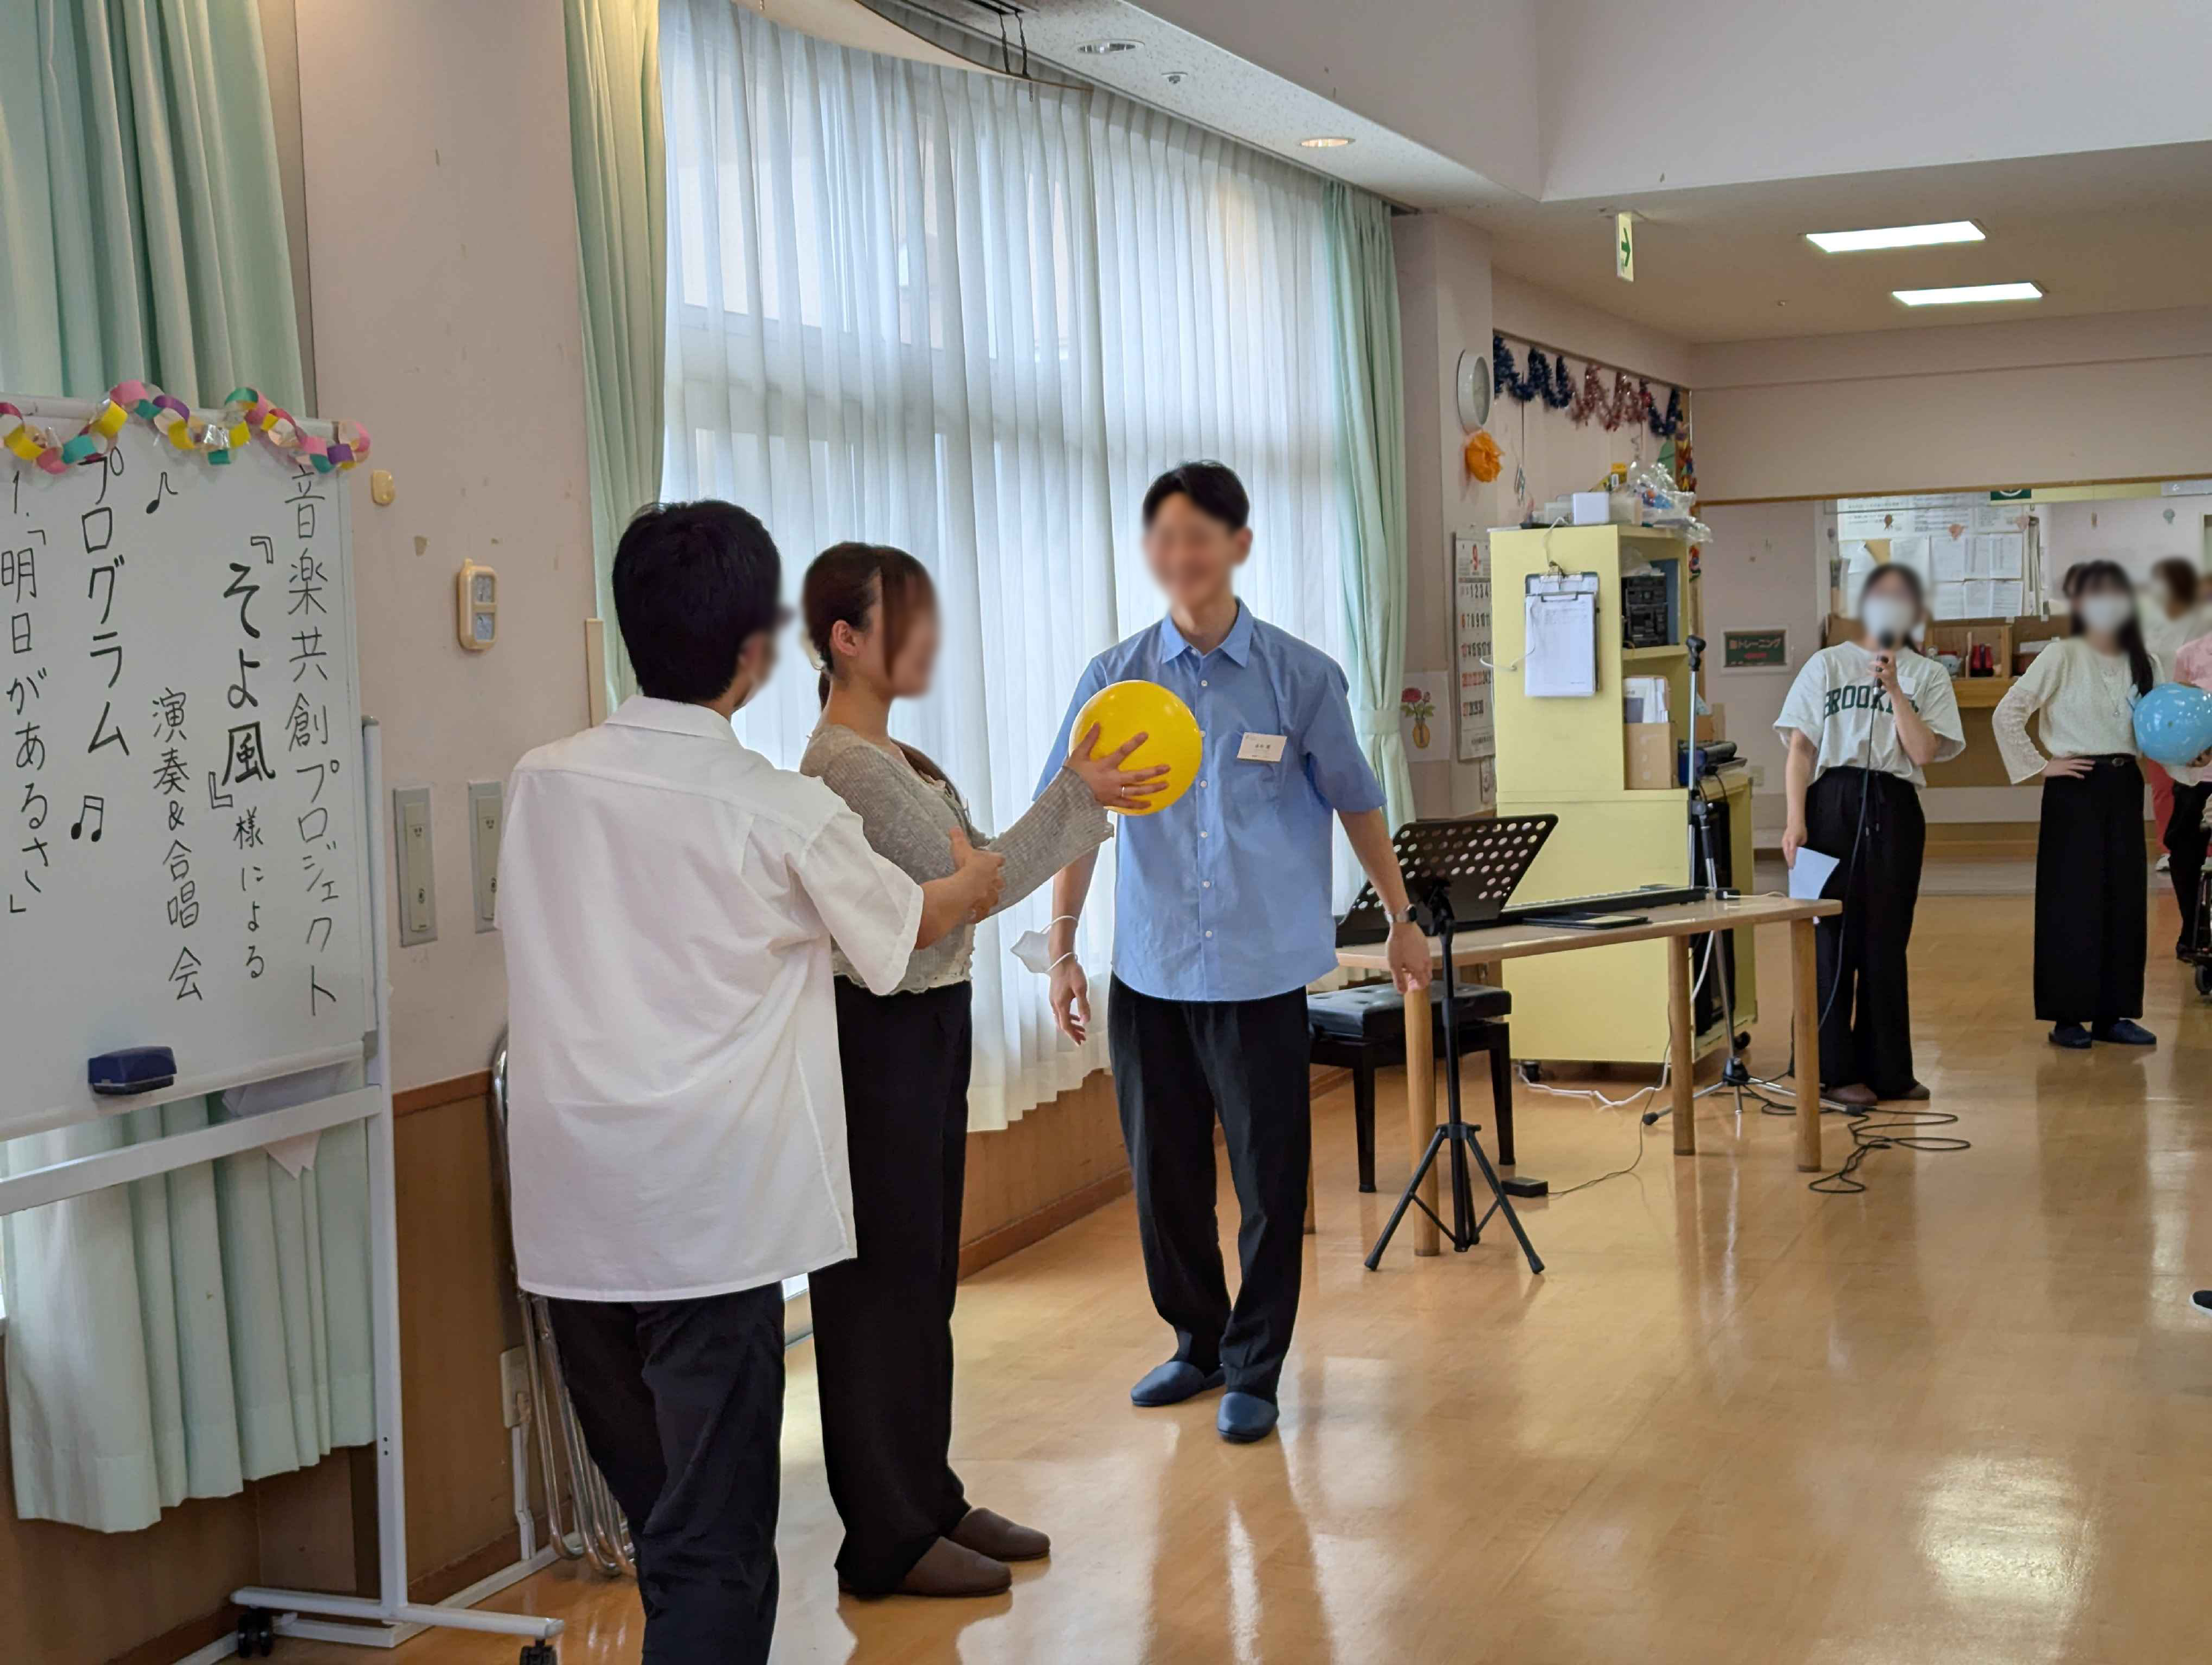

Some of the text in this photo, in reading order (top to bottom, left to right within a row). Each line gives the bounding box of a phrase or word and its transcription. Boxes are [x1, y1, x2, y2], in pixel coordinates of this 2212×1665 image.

[76, 445, 131, 756] プログラム
[284, 465, 340, 1016] 音楽共創プロジェクト
[1823, 686, 1919, 720] BROOK
